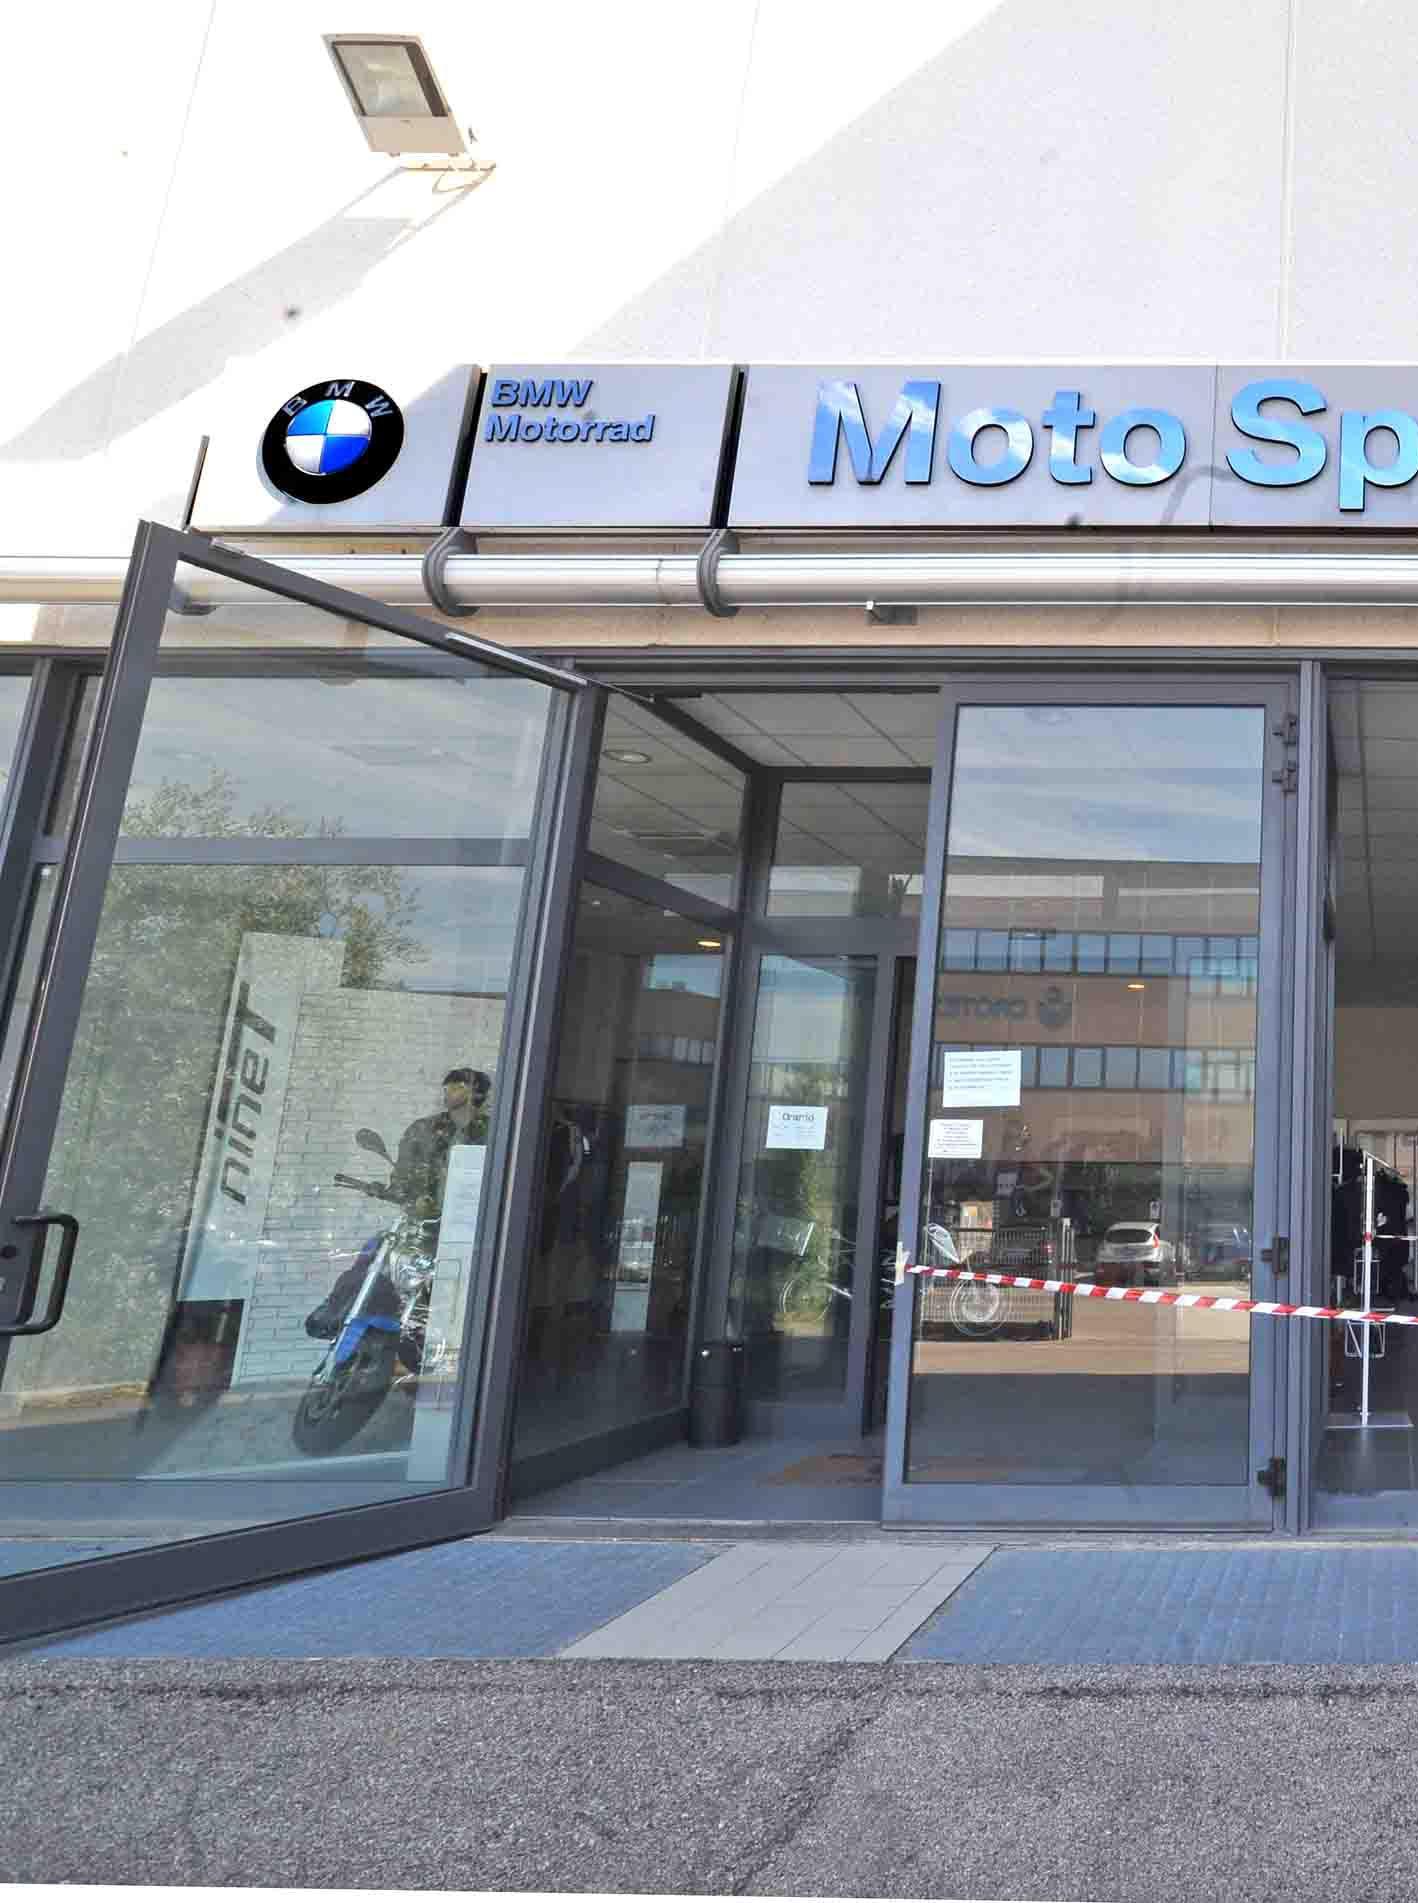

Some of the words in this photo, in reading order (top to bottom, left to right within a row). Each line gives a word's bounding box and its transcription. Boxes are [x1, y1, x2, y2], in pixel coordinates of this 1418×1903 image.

[283, 381, 393, 417] BMW
[492, 379, 594, 407] BMW
[485, 414, 656, 442] Motorrad
[808, 381, 1187, 486] Moto
